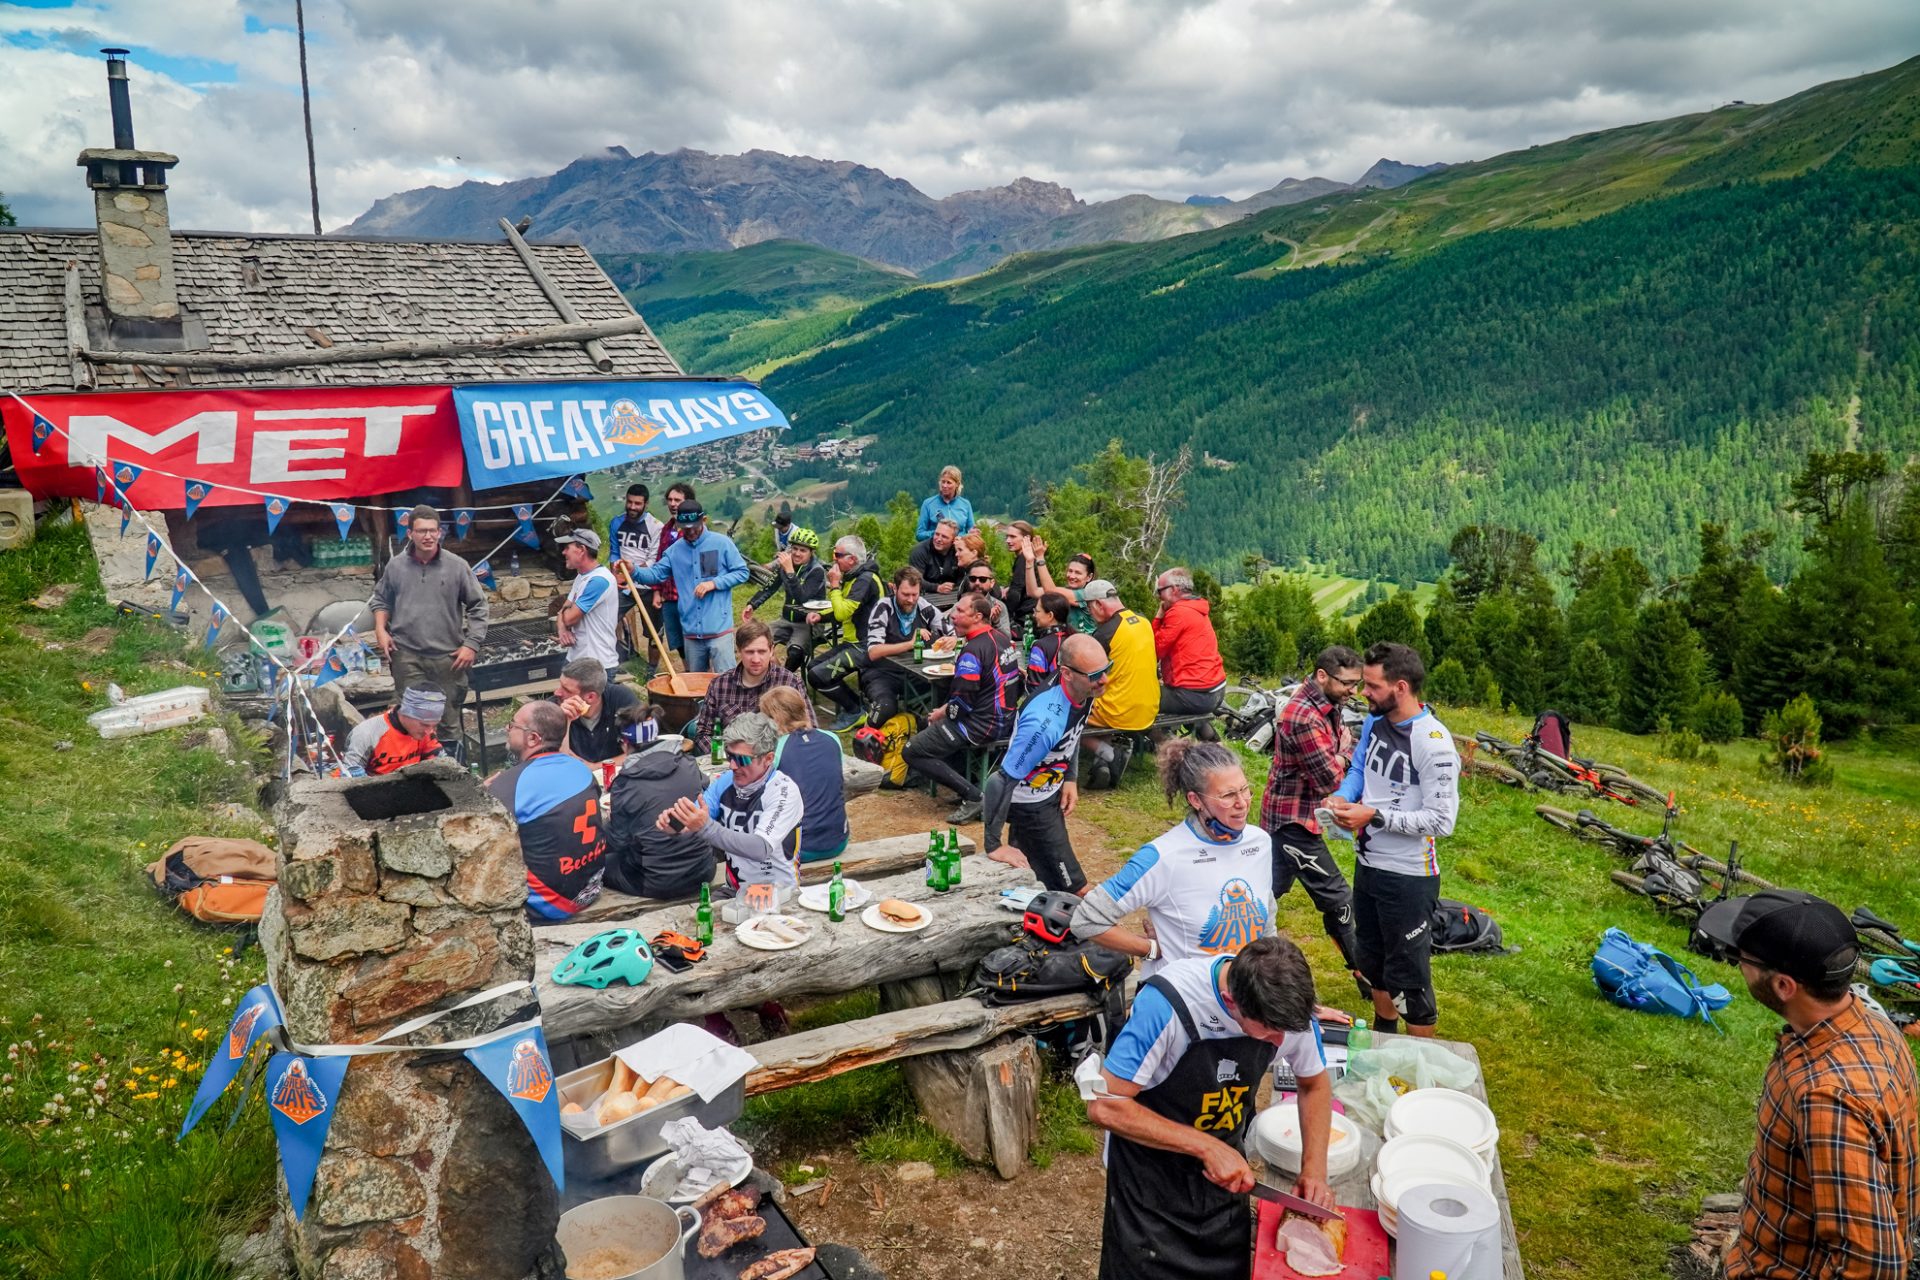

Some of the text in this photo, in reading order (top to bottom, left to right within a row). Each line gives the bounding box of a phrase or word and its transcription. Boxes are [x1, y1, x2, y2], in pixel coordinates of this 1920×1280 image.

[69, 404, 436, 484] MET
[472, 392, 772, 470] GREAT DAYS
[1219, 901, 1261, 921] GREAT
[1199, 915, 1266, 947] DAYS
[273, 1086, 324, 1111] DAYS
[1201, 1086, 1250, 1113] FAT
[1194, 1102, 1243, 1131] CAT
